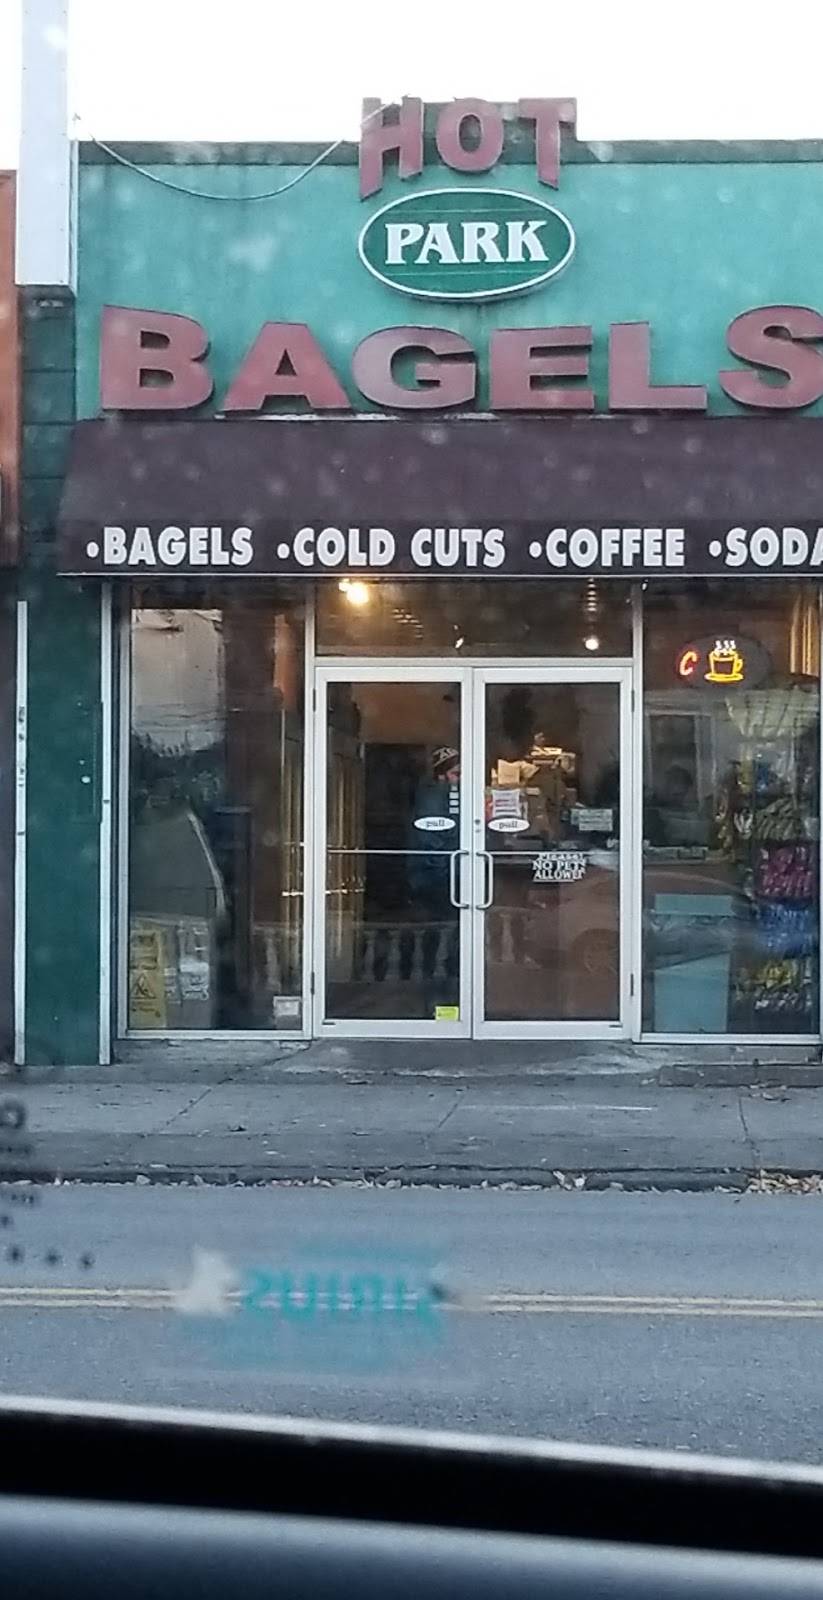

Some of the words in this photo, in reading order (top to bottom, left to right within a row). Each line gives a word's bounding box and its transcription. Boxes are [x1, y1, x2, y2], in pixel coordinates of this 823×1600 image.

[359, 97, 577, 201] HOT
[384, 220, 550, 265] PARK
[100, 304, 823, 413] BAGELS
[410, 528, 506, 568] CUTS
[532, 860, 553, 870] NO
